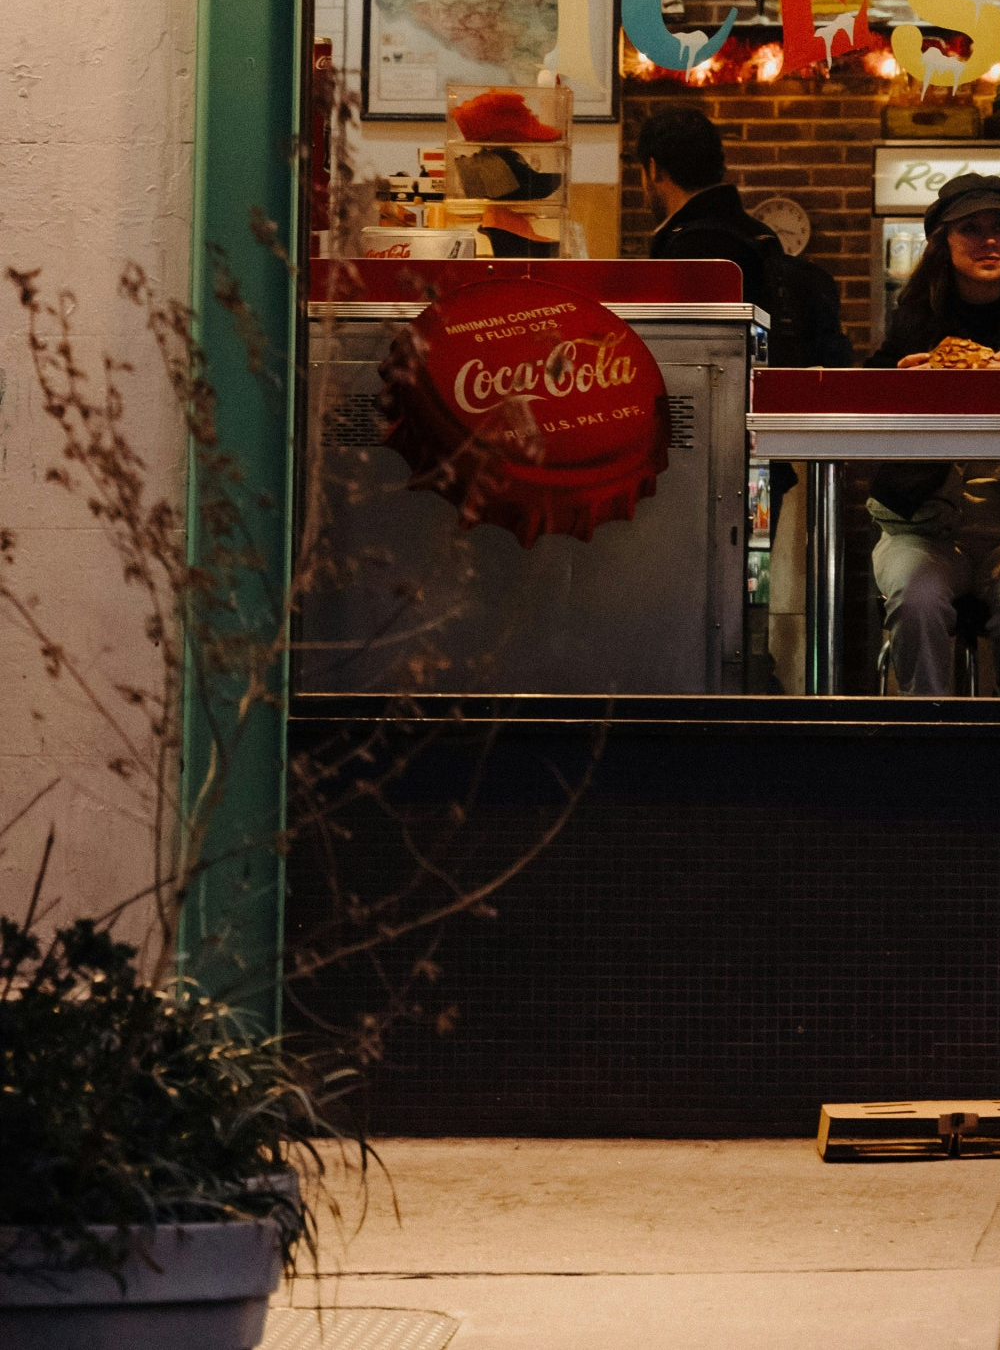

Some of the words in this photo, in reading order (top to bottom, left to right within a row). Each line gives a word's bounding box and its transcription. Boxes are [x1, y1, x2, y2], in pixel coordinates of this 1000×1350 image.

[445, 317, 506, 335] MINIMUM
[507, 302, 577, 322] CONTENTS
[474, 333, 484, 343] 6
[485, 326, 526, 341] FLUID
[454, 331, 638, 415] Coca-Cola
[543, 419, 575, 433] U.S.
[577, 411, 609, 427] PAT.
[612, 404, 645, 420] OFF.
